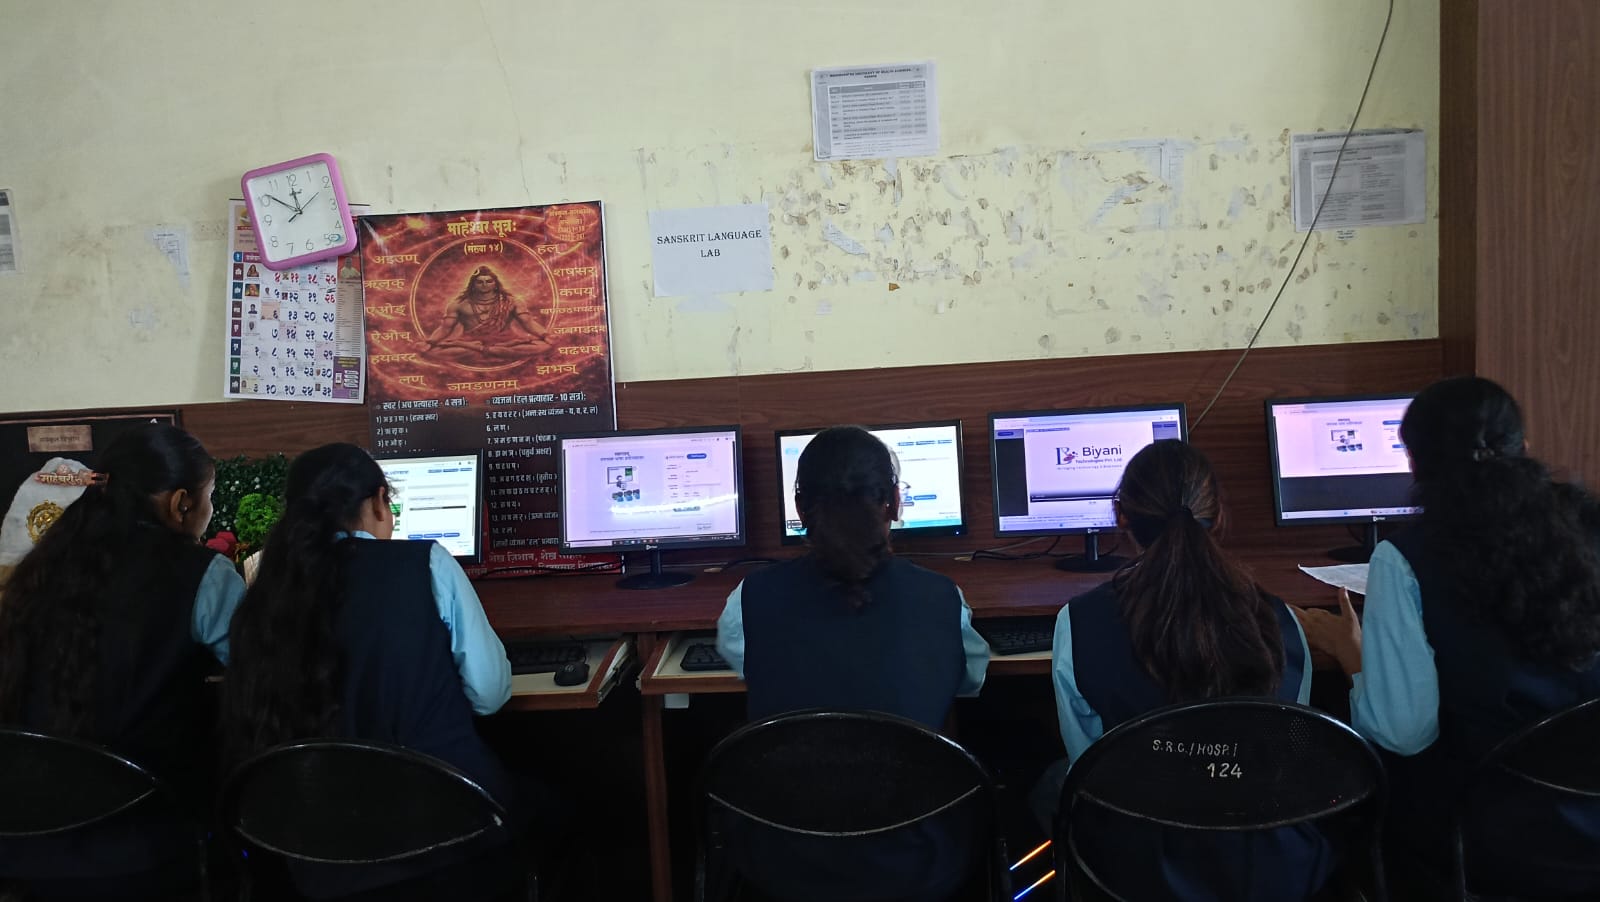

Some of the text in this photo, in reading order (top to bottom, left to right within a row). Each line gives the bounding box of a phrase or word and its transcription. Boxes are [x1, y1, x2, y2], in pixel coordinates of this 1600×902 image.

[286, 174, 297, 186] 12
[322, 176, 330, 188] 2
[329, 198, 337, 210] 3
[264, 214, 272, 226] 9
[335, 220, 341, 228] 4
[271, 236, 278, 247] 8
[656, 229, 762, 245] SANSKRIT LANGUAGE
[287, 242, 294, 254] 7
[306, 239, 314, 250] 6
[374, 254, 420, 264] अइउण्
[700, 249, 721, 258] LAB
[290, 273, 299, 283] ११
[308, 274, 317, 284] १८
[289, 292, 299, 302] १२
[325, 294, 335, 304] २६
[289, 311, 297, 320] १३
[304, 311, 316, 321] २०
[323, 312, 334, 322] २७
[272, 329, 278, 338] ७
[306, 330, 315, 340] २१
[323, 331, 333, 341] २८
[272, 347, 277, 356] ८
[304, 349, 314, 358] २२
[253, 365, 258, 375] २
[286, 367, 295, 376] १६
[304, 367, 314, 377] २३
[321, 368, 332, 378] ३०
[399, 374, 426, 385] लण्
[253, 384, 258, 392] ३
[266, 385, 276, 394] १०
[285, 385, 295, 395] १७
[302, 386, 313, 396] २४
[560, 393, 568, 401] 10
[1082, 445, 1122, 459] Biyani
[1207, 762, 1243, 779] 124
